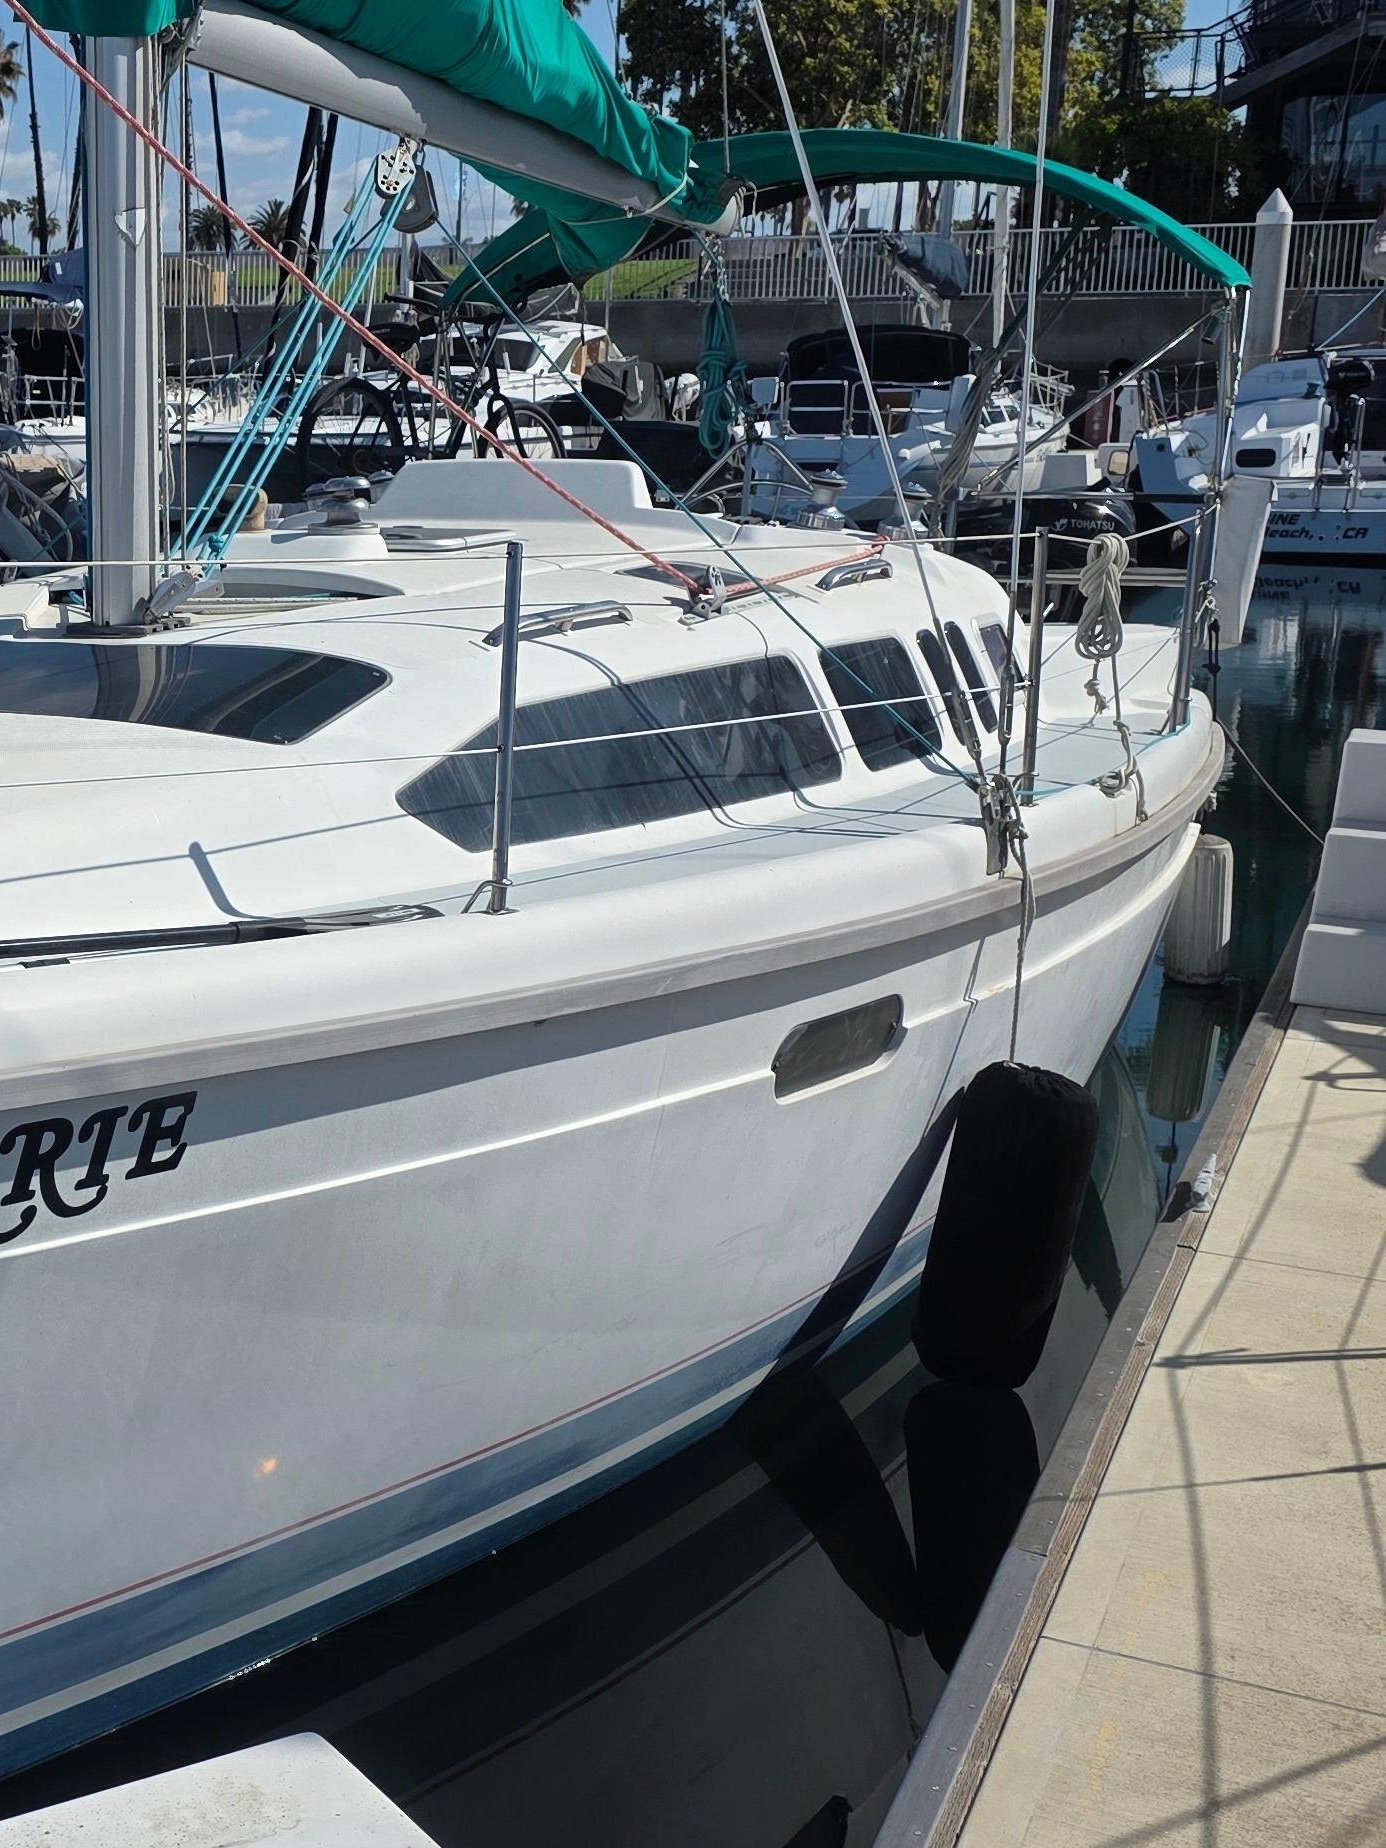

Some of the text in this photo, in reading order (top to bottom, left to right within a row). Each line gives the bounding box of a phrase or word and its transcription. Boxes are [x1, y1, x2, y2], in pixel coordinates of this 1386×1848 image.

[1070, 519, 1115, 531] TOHATSU
[1267, 513, 1301, 526] INE
[1341, 527, 1369, 540] CA
